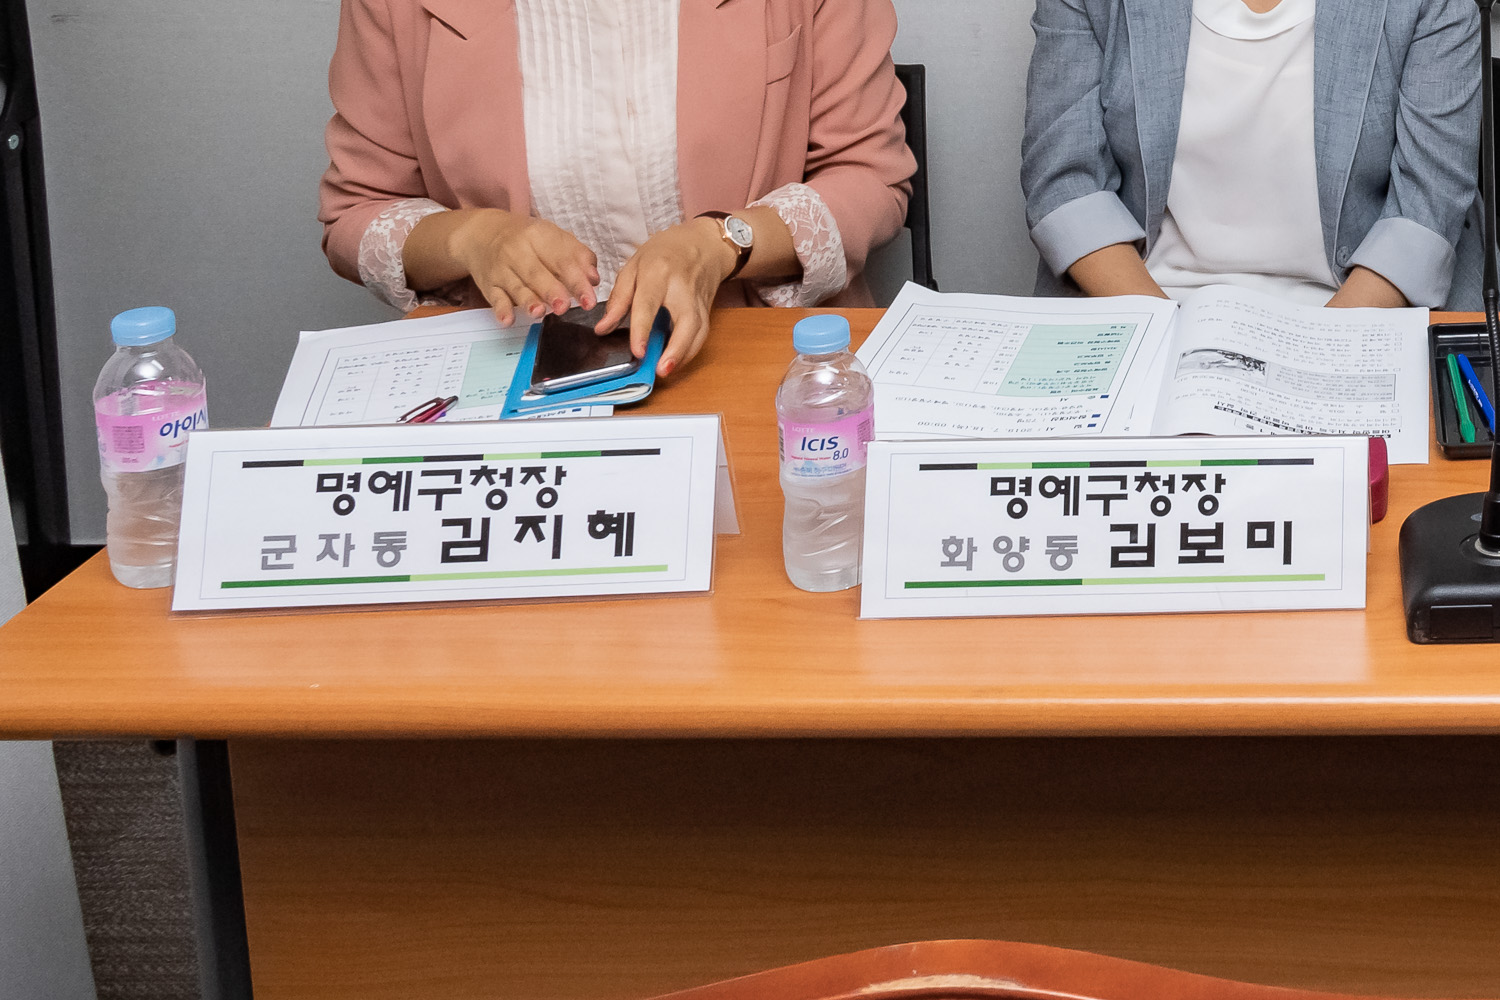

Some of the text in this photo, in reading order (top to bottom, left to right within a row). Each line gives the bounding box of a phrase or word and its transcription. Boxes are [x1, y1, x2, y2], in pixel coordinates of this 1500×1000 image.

[832, 448, 850, 461] 8.0
[317, 465, 567, 516] 명예구청장
[990, 472, 1226, 519] 명예구청장
